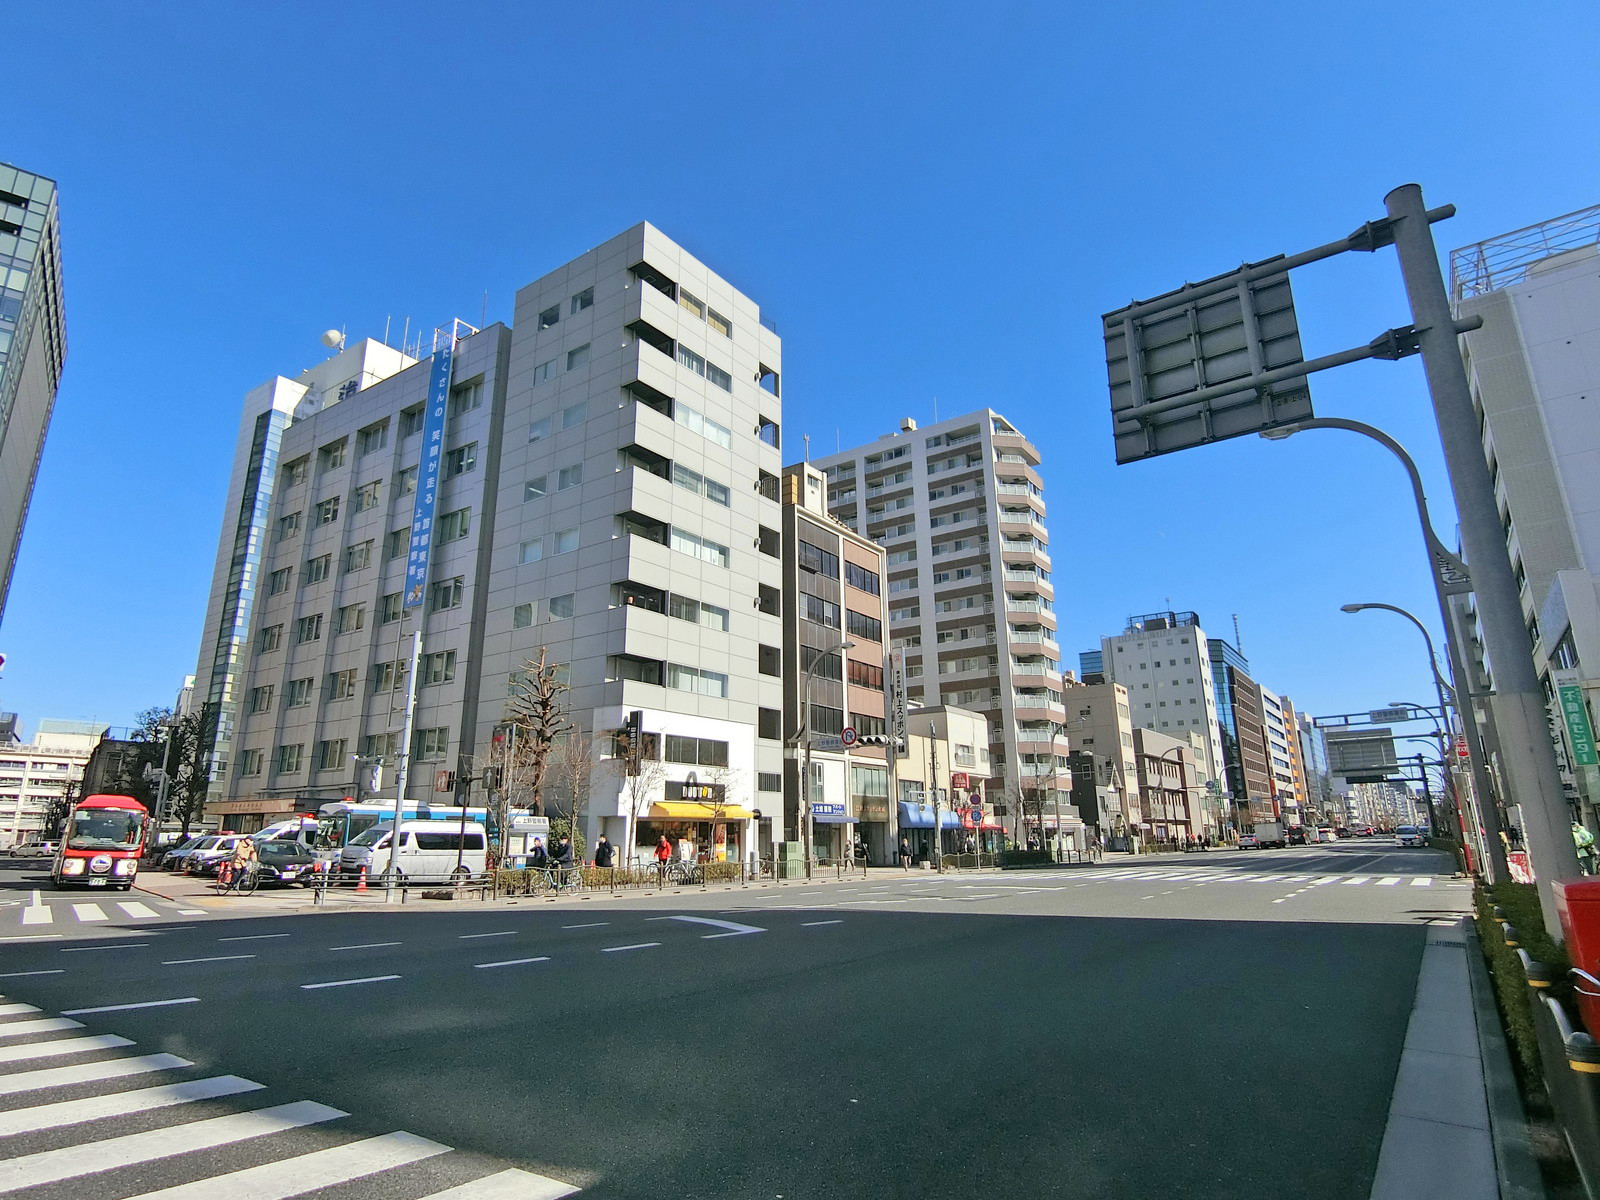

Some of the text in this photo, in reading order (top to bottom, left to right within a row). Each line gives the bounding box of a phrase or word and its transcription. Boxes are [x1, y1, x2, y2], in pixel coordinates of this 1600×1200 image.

[416, 349, 450, 580] たくさんの 笑顔が走る 首都東京
[409, 508, 422, 576] 上野警察署
[896, 691, 905, 753] 村上スッポン舗
[682, 785, 713, 799] DOUTOR
